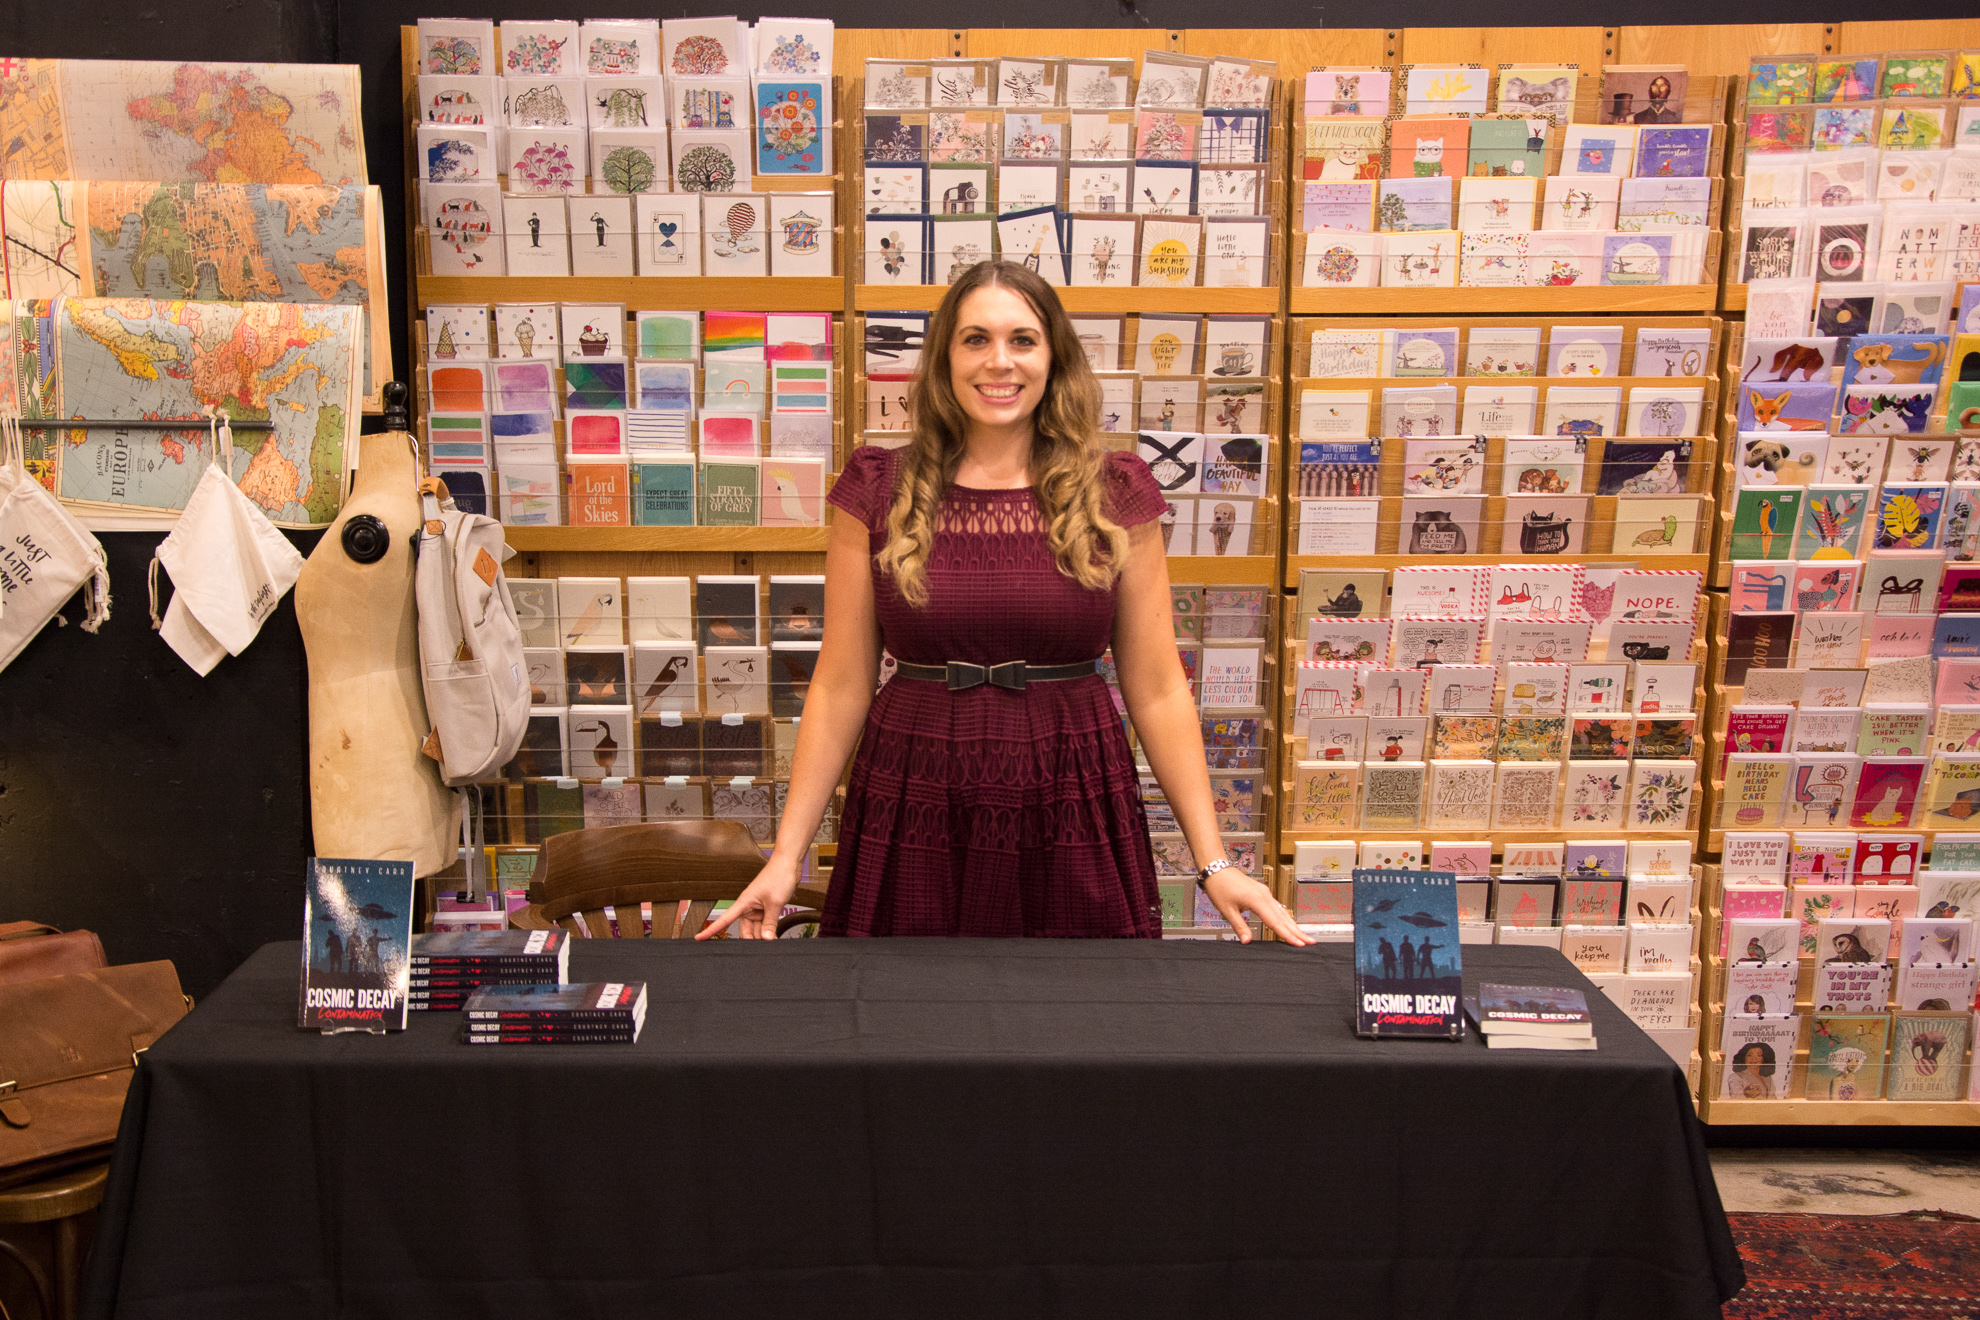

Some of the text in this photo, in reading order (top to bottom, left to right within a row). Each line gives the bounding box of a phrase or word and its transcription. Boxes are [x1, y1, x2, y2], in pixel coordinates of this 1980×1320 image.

[1314, 125, 1377, 138] GET WELL SOON
[1403, 123, 1458, 133] GOOD LUCK
[1769, 310, 1782, 320] be
[1320, 347, 1352, 359] Happy
[1318, 358, 1370, 375] Birthday
[1479, 411, 1501, 423] Life
[1322, 444, 1338, 452] YOU'RE
[1207, 469, 1258, 481] BEAUTIFUL
[586, 476, 614, 493] Lord
[1222, 481, 1241, 492] DAY
[645, 490, 688, 500] EXPECT GREAT
[717, 486, 745, 496] FIFTY
[589, 495, 612, 505] of the
[710, 494, 753, 504] STRANDS
[645, 501, 688, 511] CELEBRATIONS
[710, 503, 751, 513] OF GREY
[584, 505, 619, 522] Skies
[1536, 544, 1559, 552] HUMAN
[1626, 598, 1680, 609] NOPE.
[1210, 666, 1250, 674] THE WORLD
[1206, 676, 1253, 684] WOULD HAVE
[1204, 685, 1221, 693] LESS
[1203, 695, 1253, 703] WITHOUT YOU
[378, 867, 405, 875] CARR
[1582, 945, 1602, 953] you
[1575, 951, 1595, 961] keep
[1828, 971, 1879, 980] YOU'RE
[1831, 982, 1870, 990] IN MY
[1949, 981, 1965, 989] girl
[307, 988, 397, 1009] COSMIC DECAY
[1827, 992, 1872, 1000] THOTS
[1364, 993, 1456, 1015] COSMIC DECAY
[1488, 1011, 1582, 1020] COSMIC DECAY
[1650, 1015, 1672, 1023] EYES
